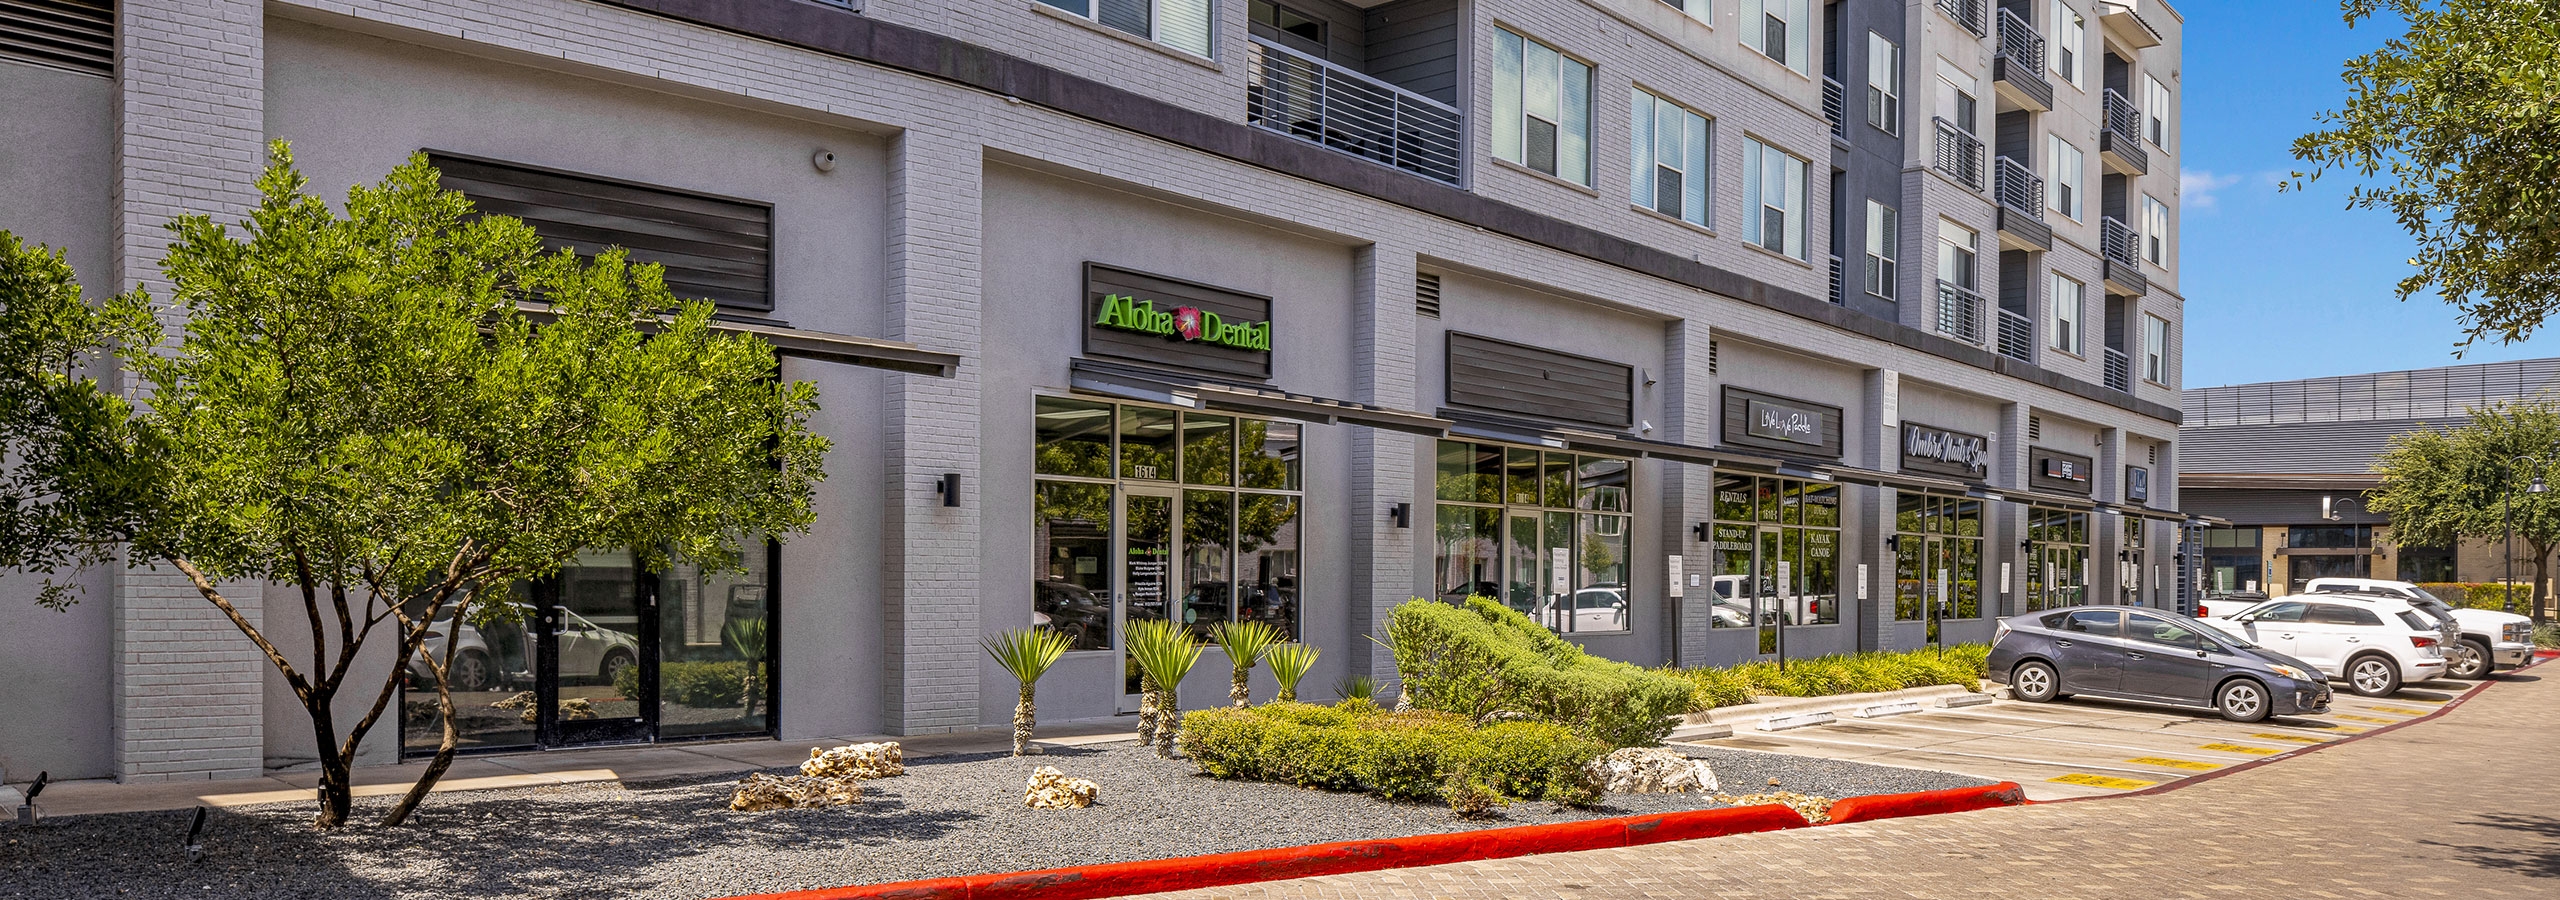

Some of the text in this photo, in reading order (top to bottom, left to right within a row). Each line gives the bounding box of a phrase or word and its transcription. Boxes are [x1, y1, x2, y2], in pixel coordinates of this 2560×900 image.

[1096, 293, 1271, 351] Aloha Dental
[1909, 426, 1942, 457] Ombre
[1941, 432, 1966, 463] Nails
[1971, 438, 1988, 473] Spa
[1135, 465, 1156, 479] 1614
[1720, 491, 1748, 503] RENTALS
[1718, 529, 1747, 539] STAND-UP
[1810, 533, 1830, 544] KAYAK
[1128, 547, 1144, 555] Aloha
[1713, 541, 1752, 551] PADDLEBOARD
[1810, 547, 1831, 558] CANOE
